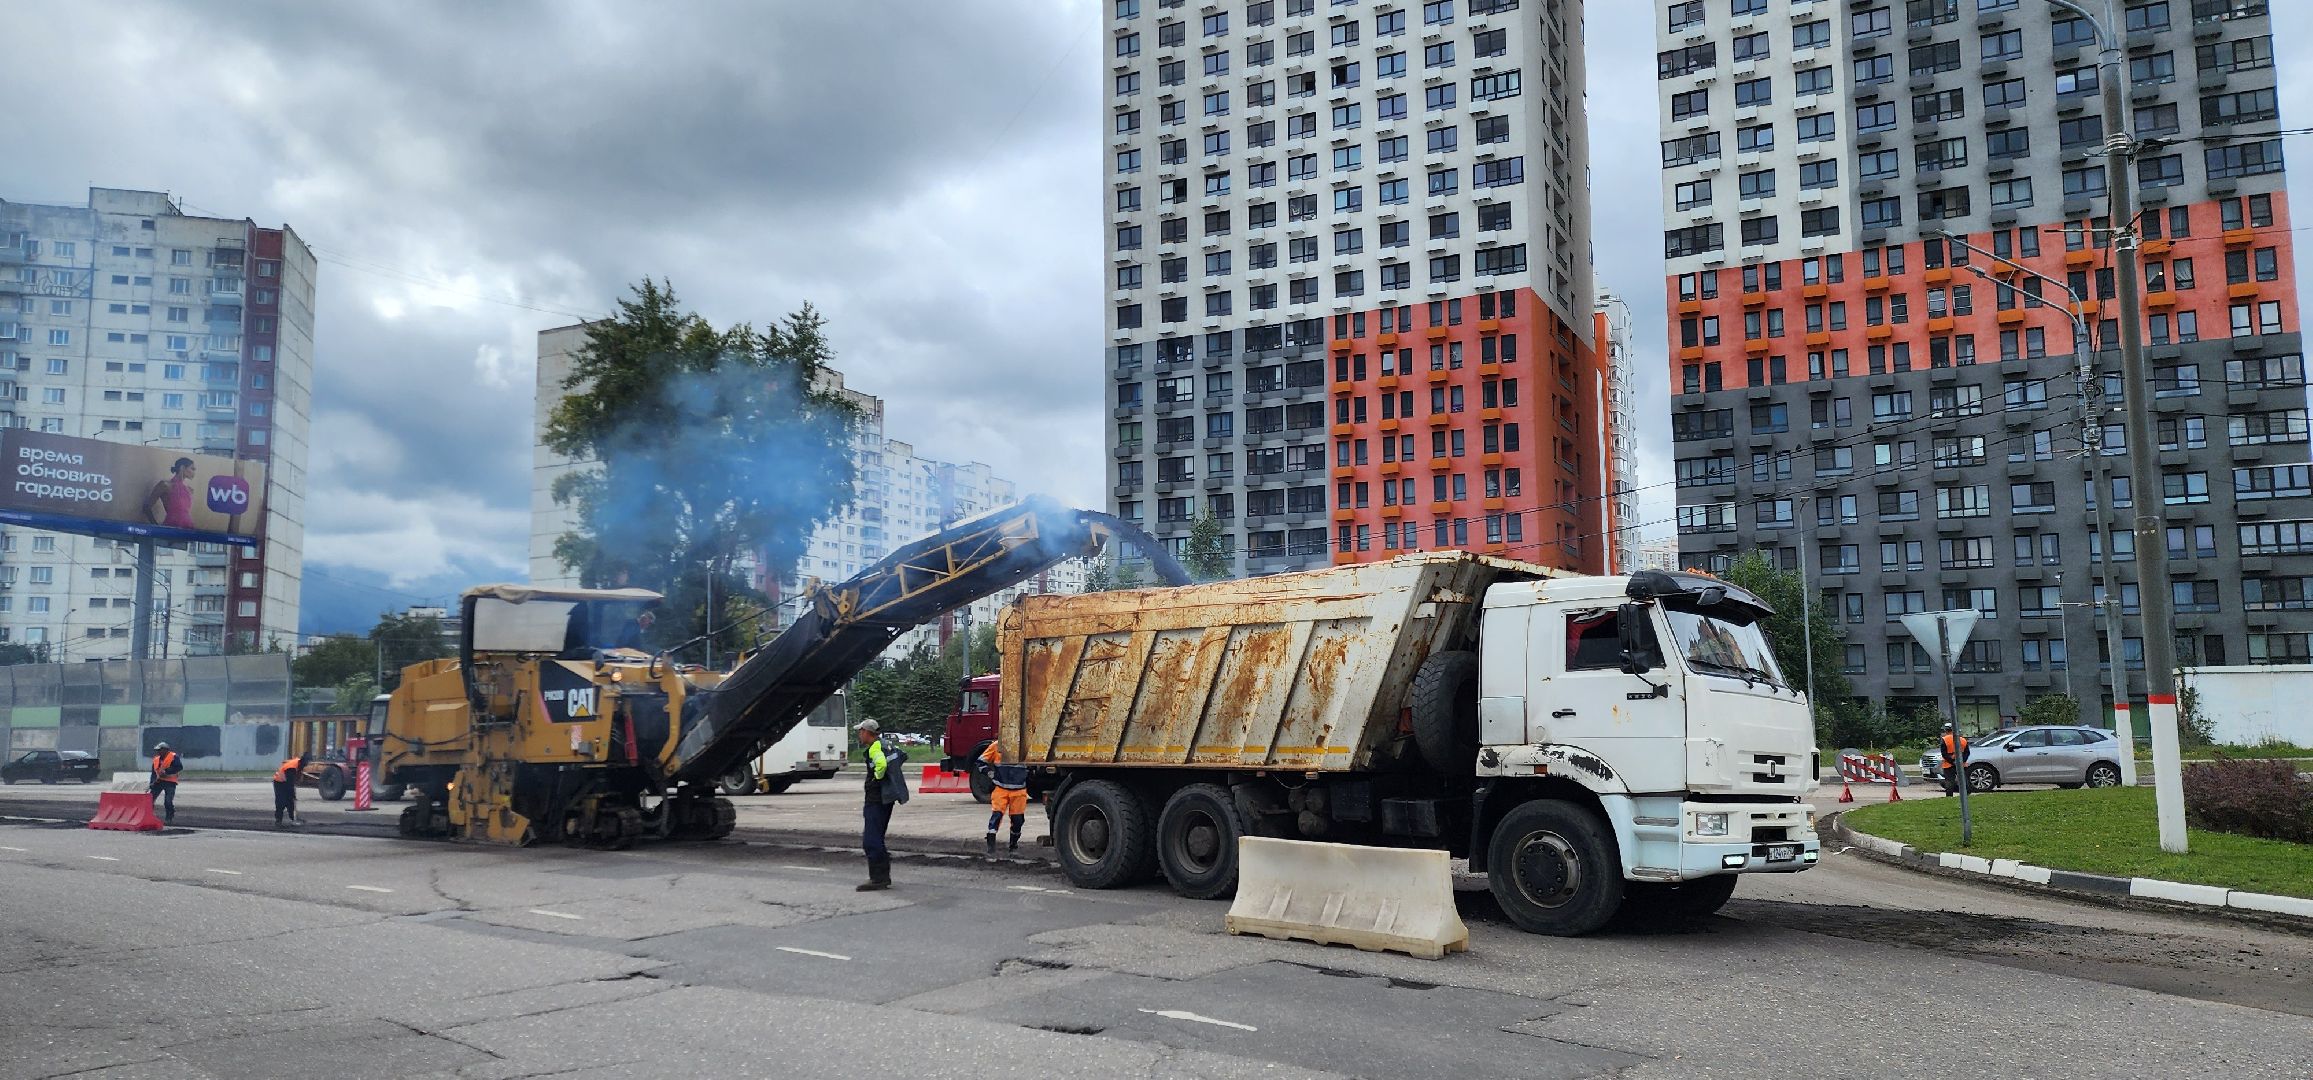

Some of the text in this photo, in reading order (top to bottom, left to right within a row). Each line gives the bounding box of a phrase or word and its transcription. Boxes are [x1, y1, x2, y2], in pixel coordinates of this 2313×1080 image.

[19, 447, 83, 465] время
[17, 463, 112, 486] обновить
[15, 481, 113, 502] гардероб
[210, 484, 247, 505] wb
[567, 688, 594, 717] CAT
